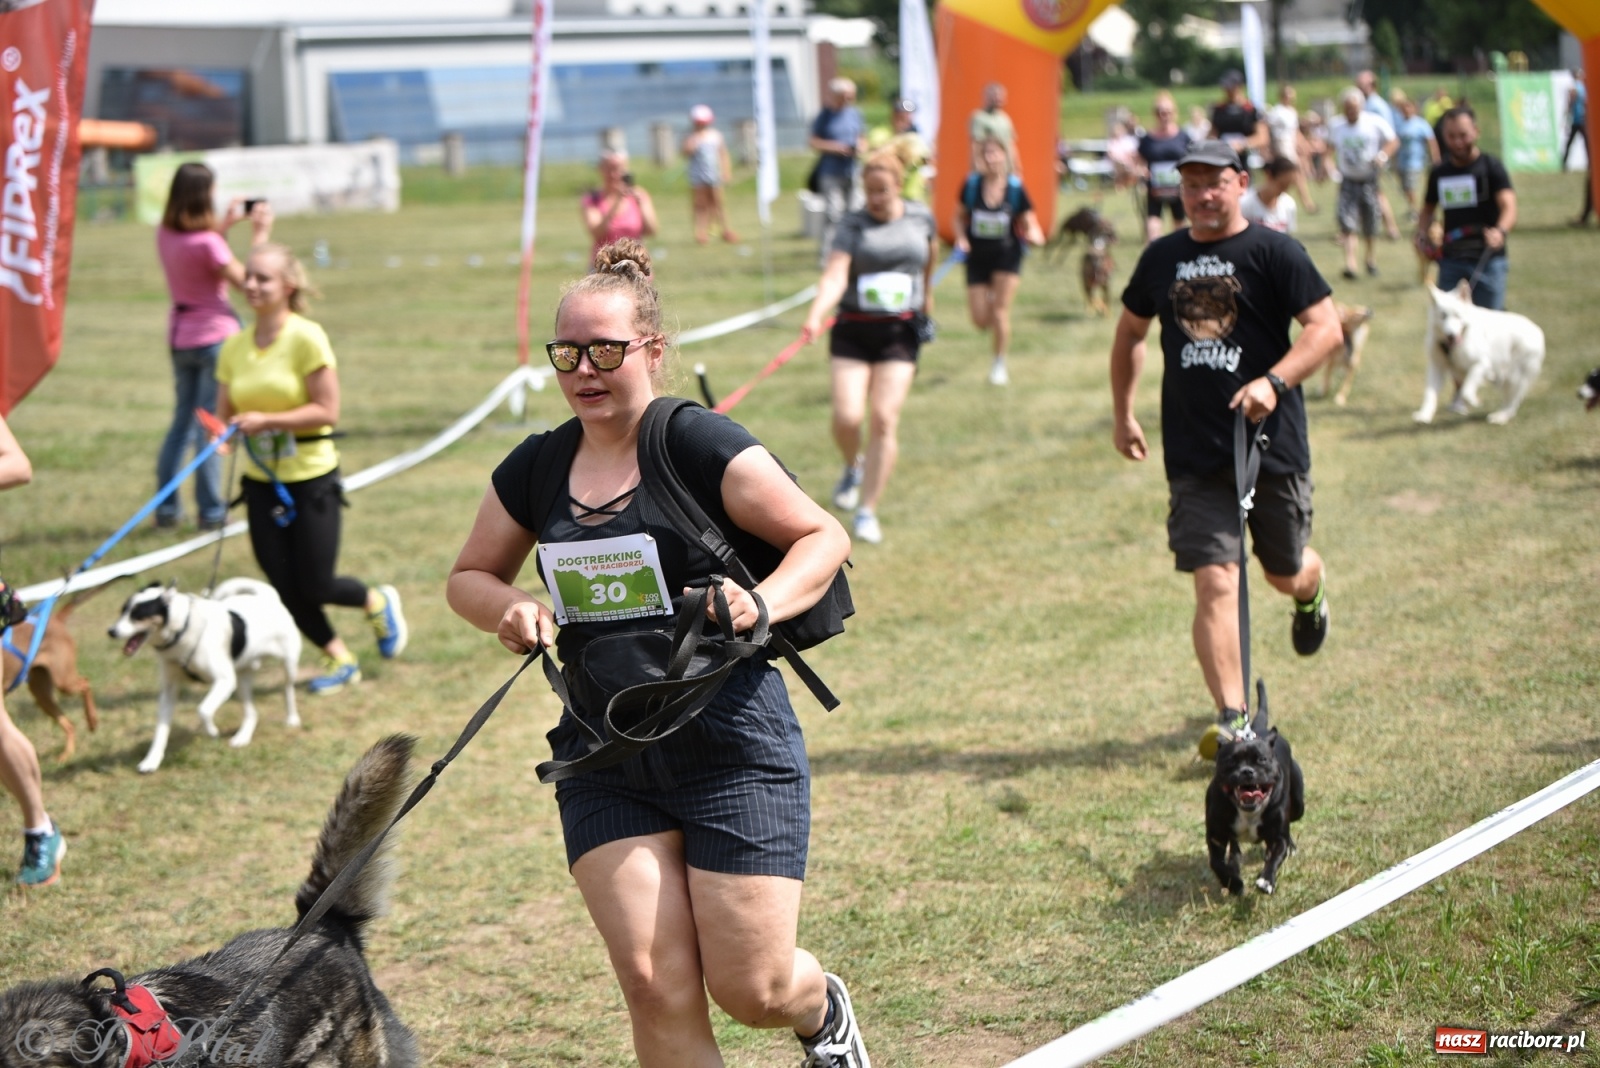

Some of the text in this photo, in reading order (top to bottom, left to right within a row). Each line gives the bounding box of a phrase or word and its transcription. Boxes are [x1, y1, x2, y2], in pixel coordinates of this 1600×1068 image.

[557, 550, 642, 567] DOGTREKKING
[600, 560, 644, 571] RACIBORZU
[590, 581, 627, 605] 30
